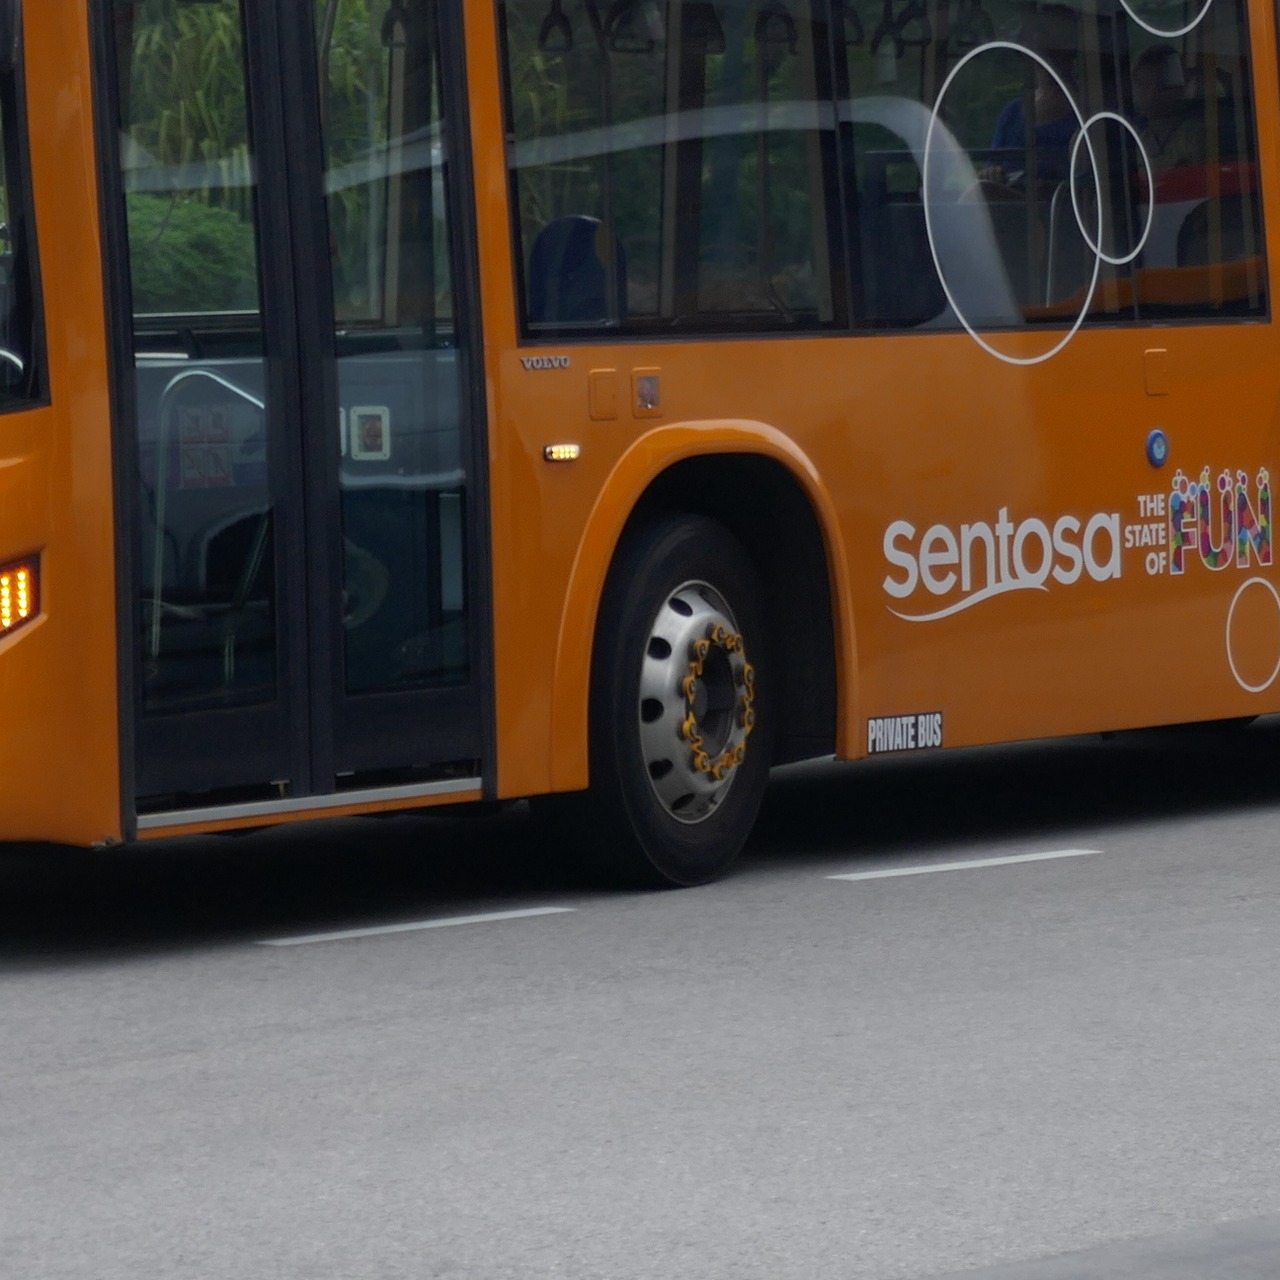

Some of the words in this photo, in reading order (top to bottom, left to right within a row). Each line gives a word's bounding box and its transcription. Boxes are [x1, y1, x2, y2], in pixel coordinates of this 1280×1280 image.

[521, 356, 570, 370] VOLVO
[1137, 494, 1166, 518] THE
[1168, 466, 1273, 575] FUN
[1124, 523, 1166, 548] STATE
[882, 506, 1122, 599] sentosa
[1145, 552, 1167, 576] OF
[868, 716, 916, 754] PRIVATE
[917, 713, 942, 748] BUS
